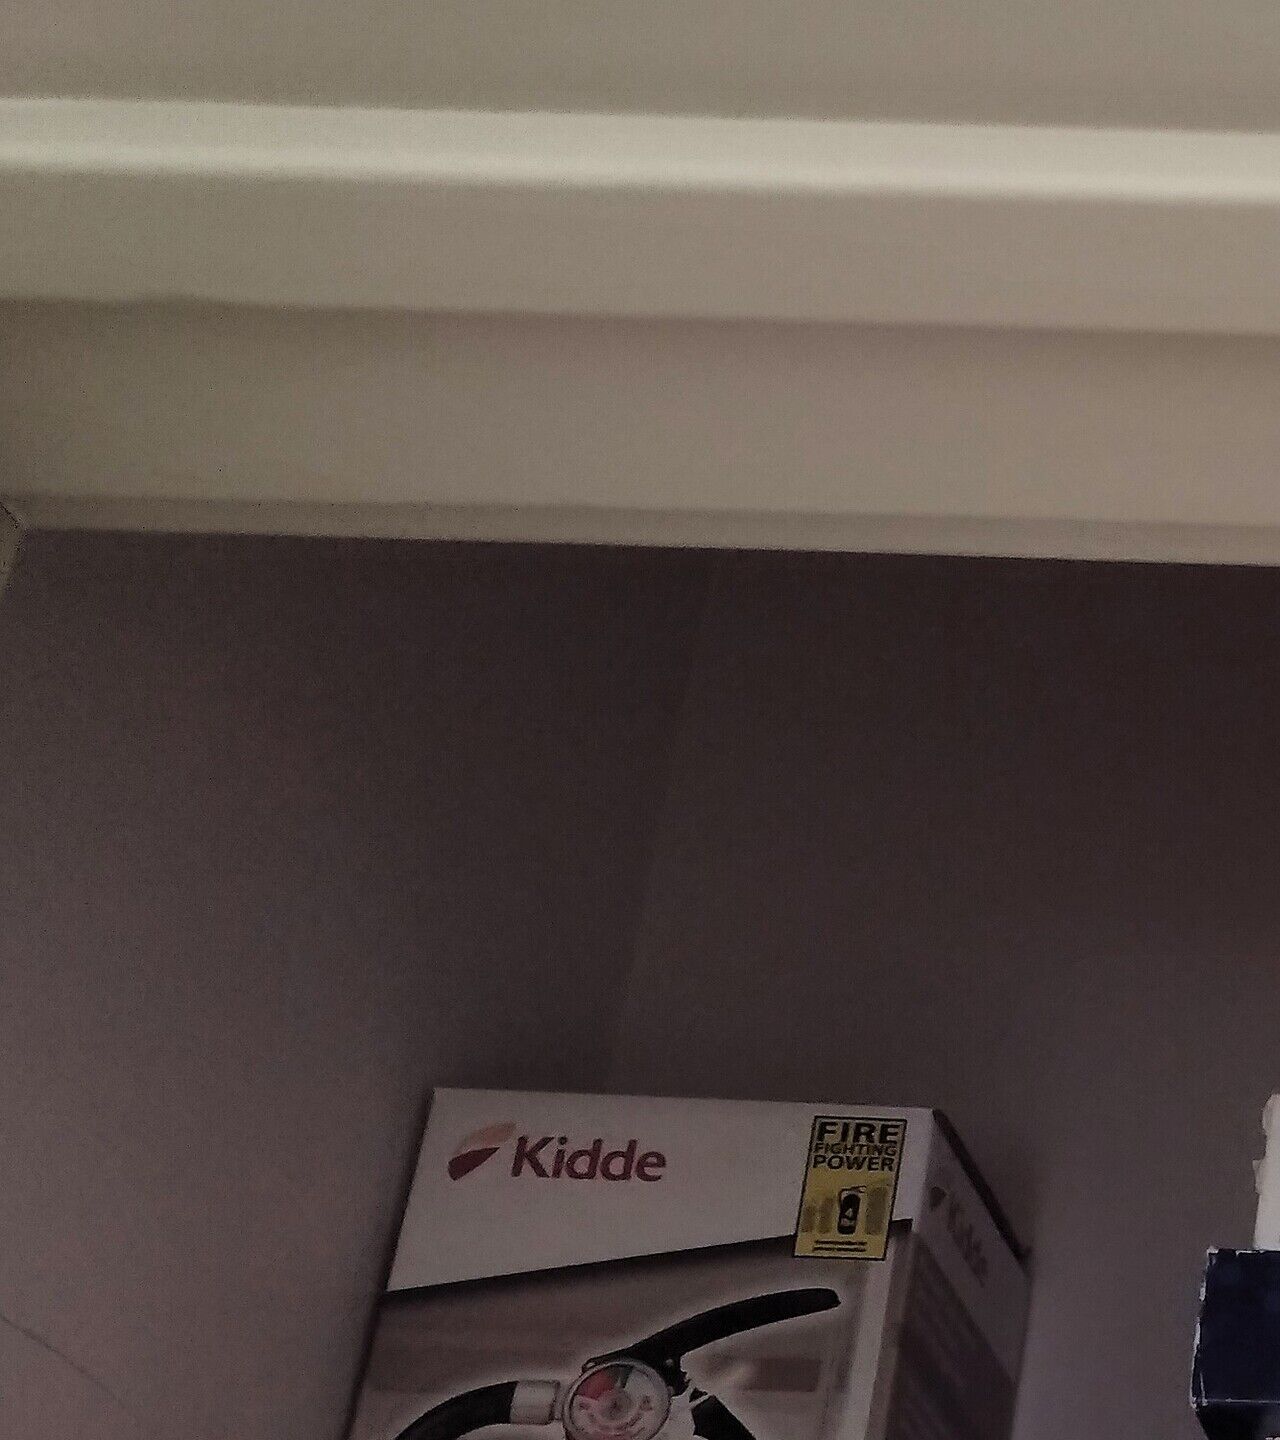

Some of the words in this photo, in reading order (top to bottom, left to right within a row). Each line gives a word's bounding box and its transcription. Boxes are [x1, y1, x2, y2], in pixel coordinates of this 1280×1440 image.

[816, 1121, 901, 1144] FIRE
[511, 1134, 667, 1183] Kidde
[813, 1142, 899, 1157] FIGHTING
[812, 1155, 895, 1171] POWER
